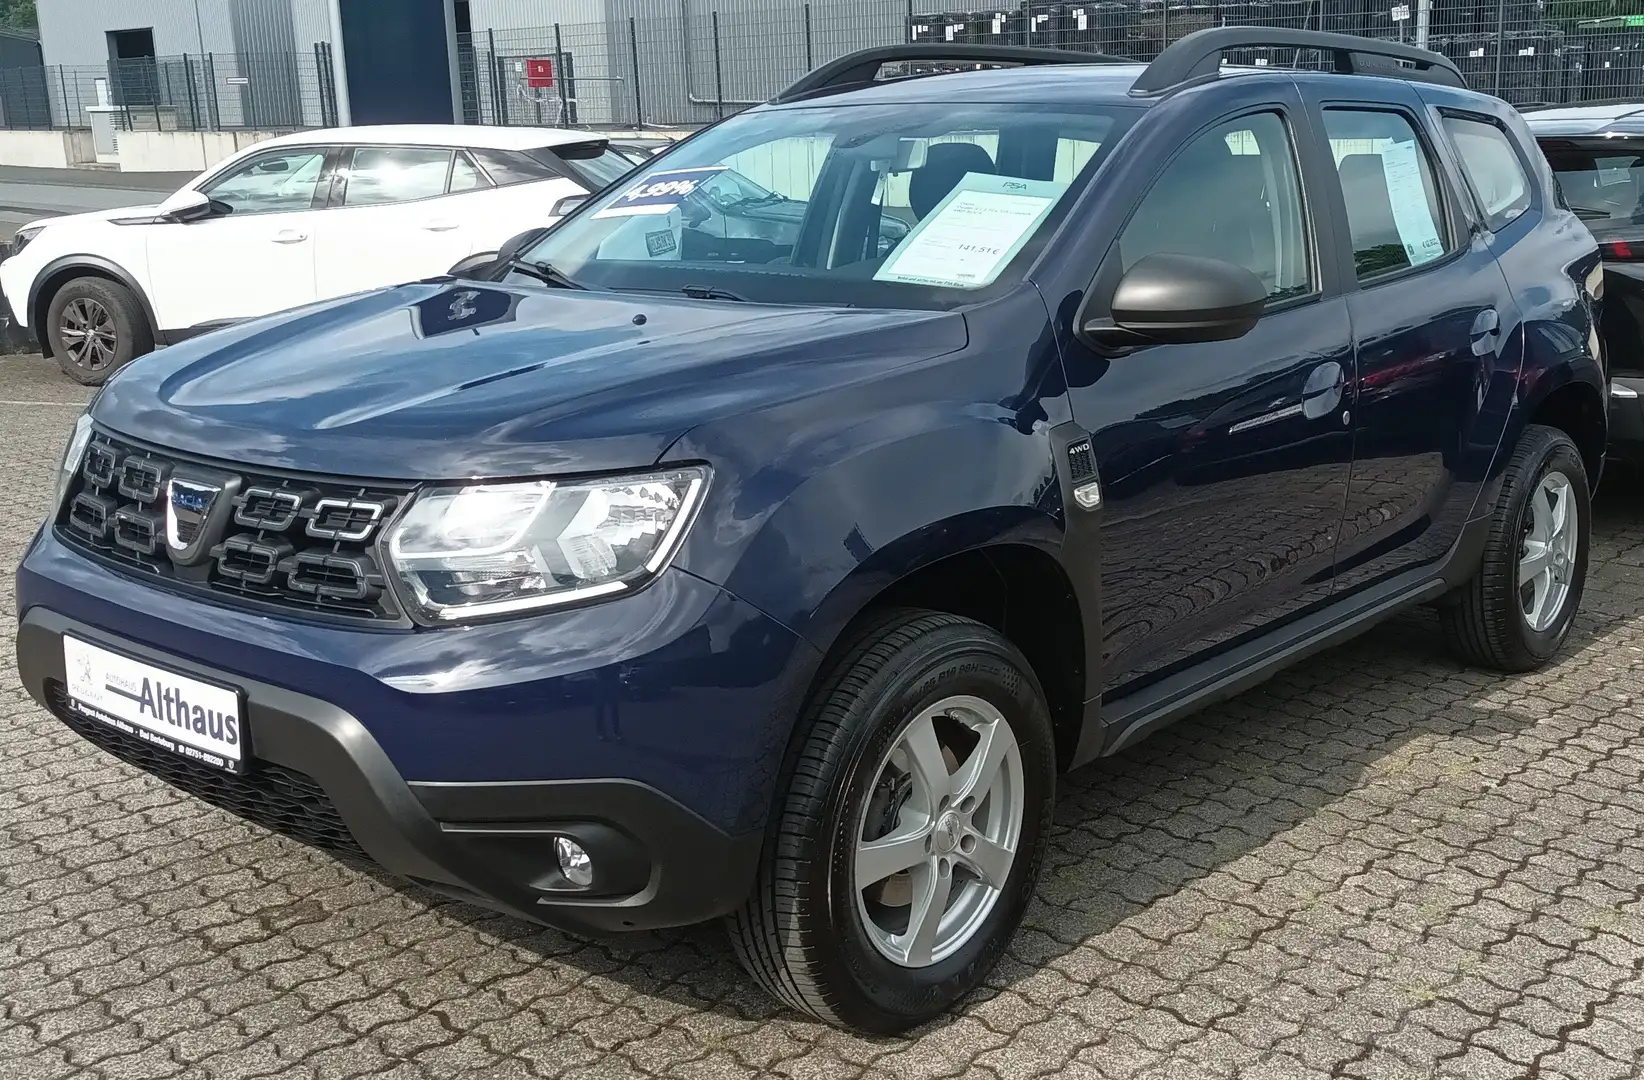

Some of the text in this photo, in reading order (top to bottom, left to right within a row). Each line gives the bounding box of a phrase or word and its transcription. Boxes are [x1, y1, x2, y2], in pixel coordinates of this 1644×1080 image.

[1002, 181, 1027, 190] PSA
[1069, 443, 1089, 455] 4WD
[106, 672, 137, 692] AUTOHAUS
[139, 677, 238, 745] Althaus
